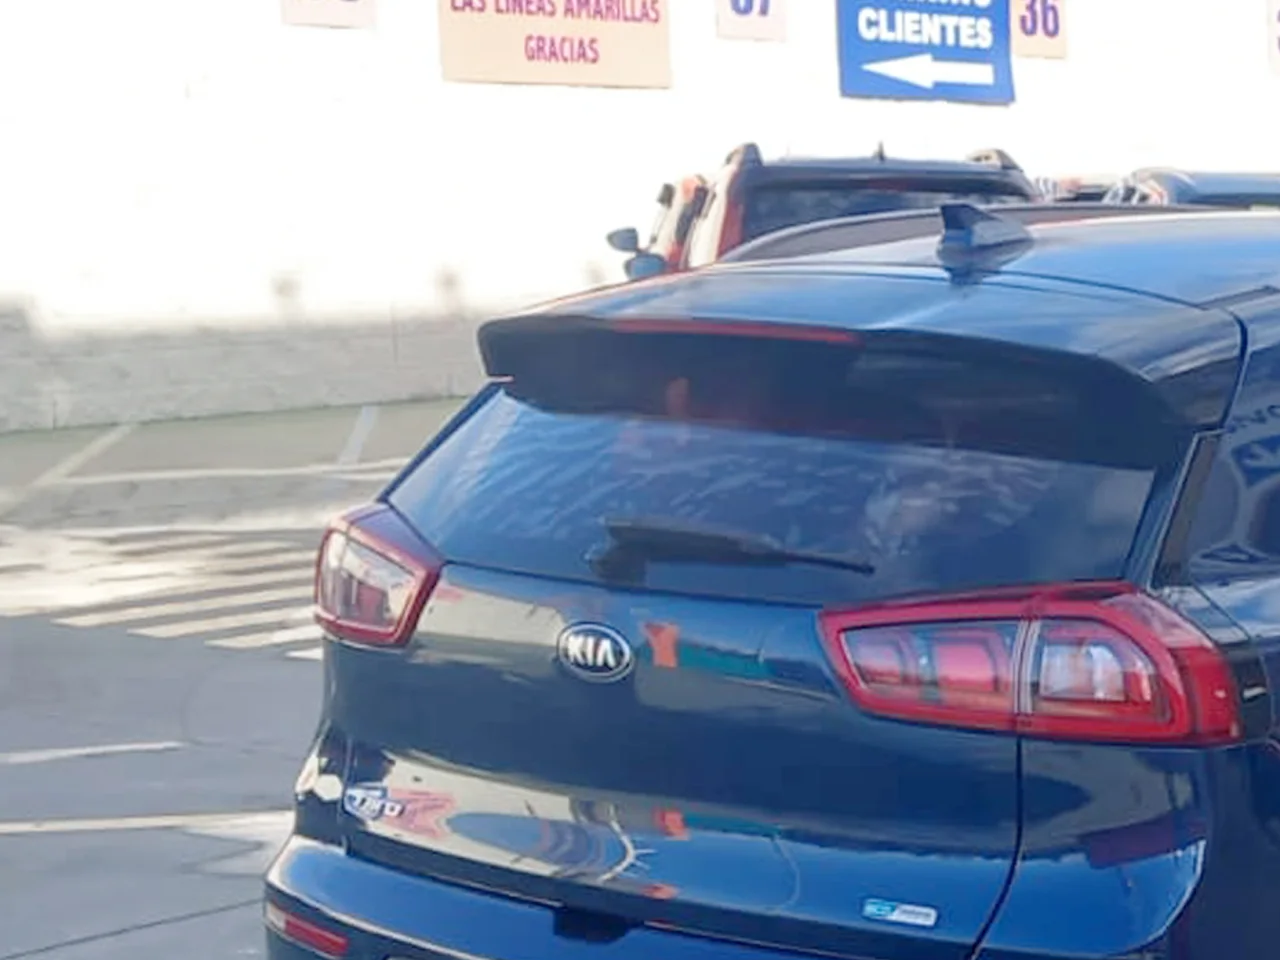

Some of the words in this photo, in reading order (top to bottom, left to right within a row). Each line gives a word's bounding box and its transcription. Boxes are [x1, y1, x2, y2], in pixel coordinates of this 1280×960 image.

[563, 0, 661, 23] AMARILLAS
[857, 8, 993, 49] CLIENTES
[1020, 0, 1060, 38] 36
[524, 34, 600, 64] GRACIAS
[566, 633, 617, 669] KIA
